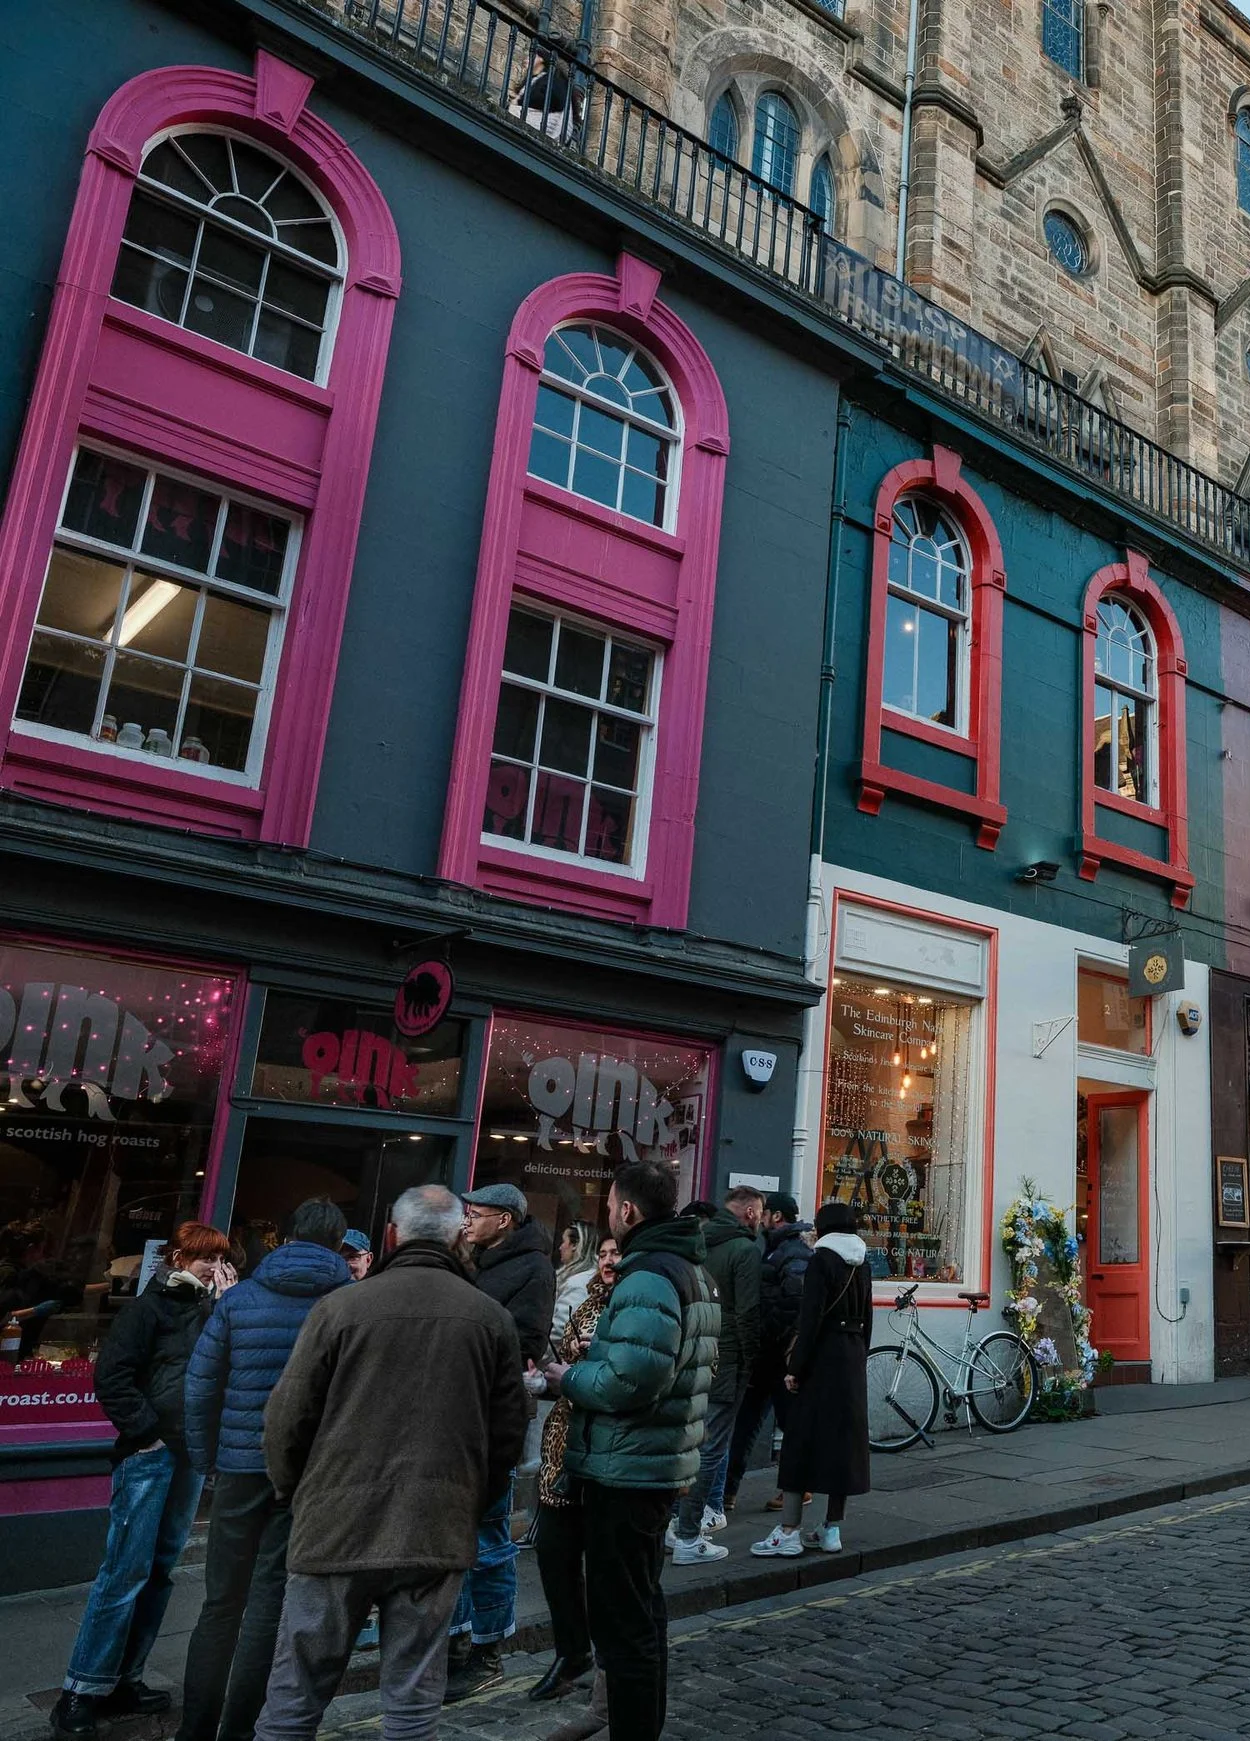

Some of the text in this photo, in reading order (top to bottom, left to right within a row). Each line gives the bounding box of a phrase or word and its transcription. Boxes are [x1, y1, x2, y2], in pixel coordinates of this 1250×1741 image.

[882, 277, 967, 343] SHOP
[841, 1004, 860, 1019] The
[866, 1009, 917, 1031] Edinburgh
[853, 1023, 894, 1041] Skincare
[6, 1127, 160, 1147] scottish hog roasts
[830, 1129, 854, 1139] 100%
[524, 1162, 614, 1179] delicious scottish
[0, 1391, 99, 1407] roast.co.u
